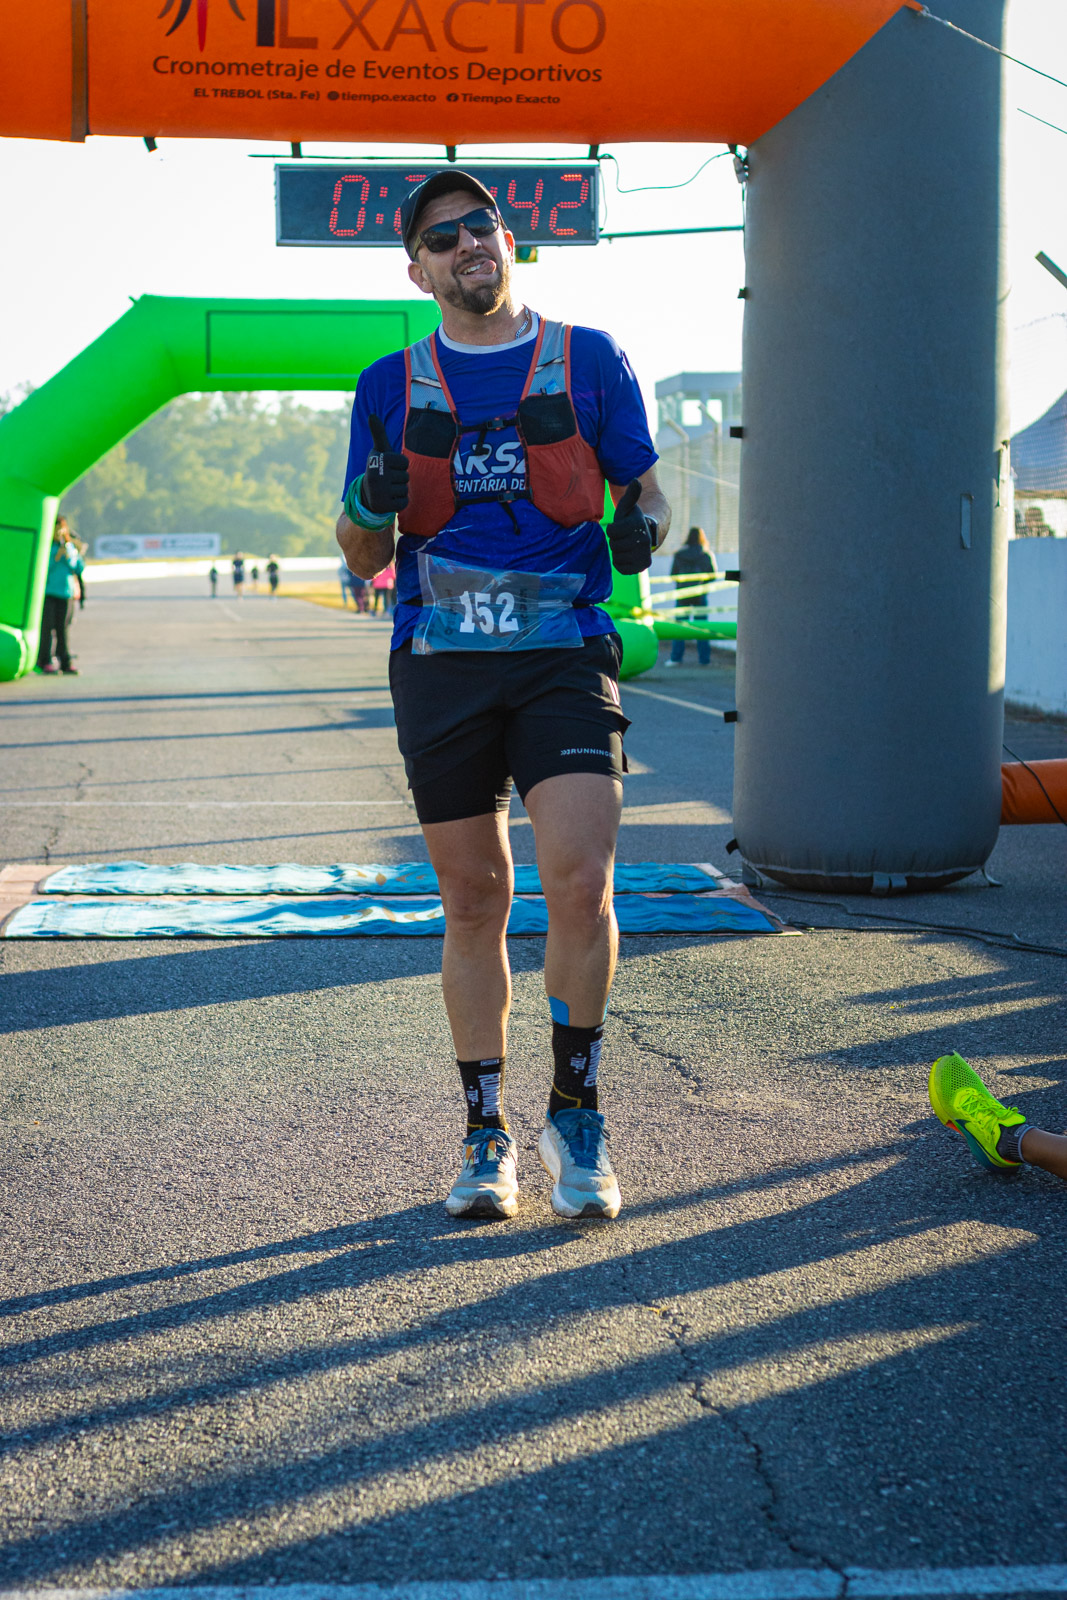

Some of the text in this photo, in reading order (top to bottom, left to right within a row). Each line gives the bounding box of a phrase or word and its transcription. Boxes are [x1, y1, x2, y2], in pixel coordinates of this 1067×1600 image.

[152, 55, 603, 86] Cronometraje de Eventos Deportivos
[193, 87, 210, 98] EL
[211, 87, 265, 99] TREBOL
[267, 88, 298, 100] (Sta.
[300, 89, 321, 100] Fe)
[461, 93, 513, 105] Tiempo
[515, 94, 561, 104] Exacto
[459, 590, 520, 635] 152
[478, 1072, 502, 1117] RUNNING
